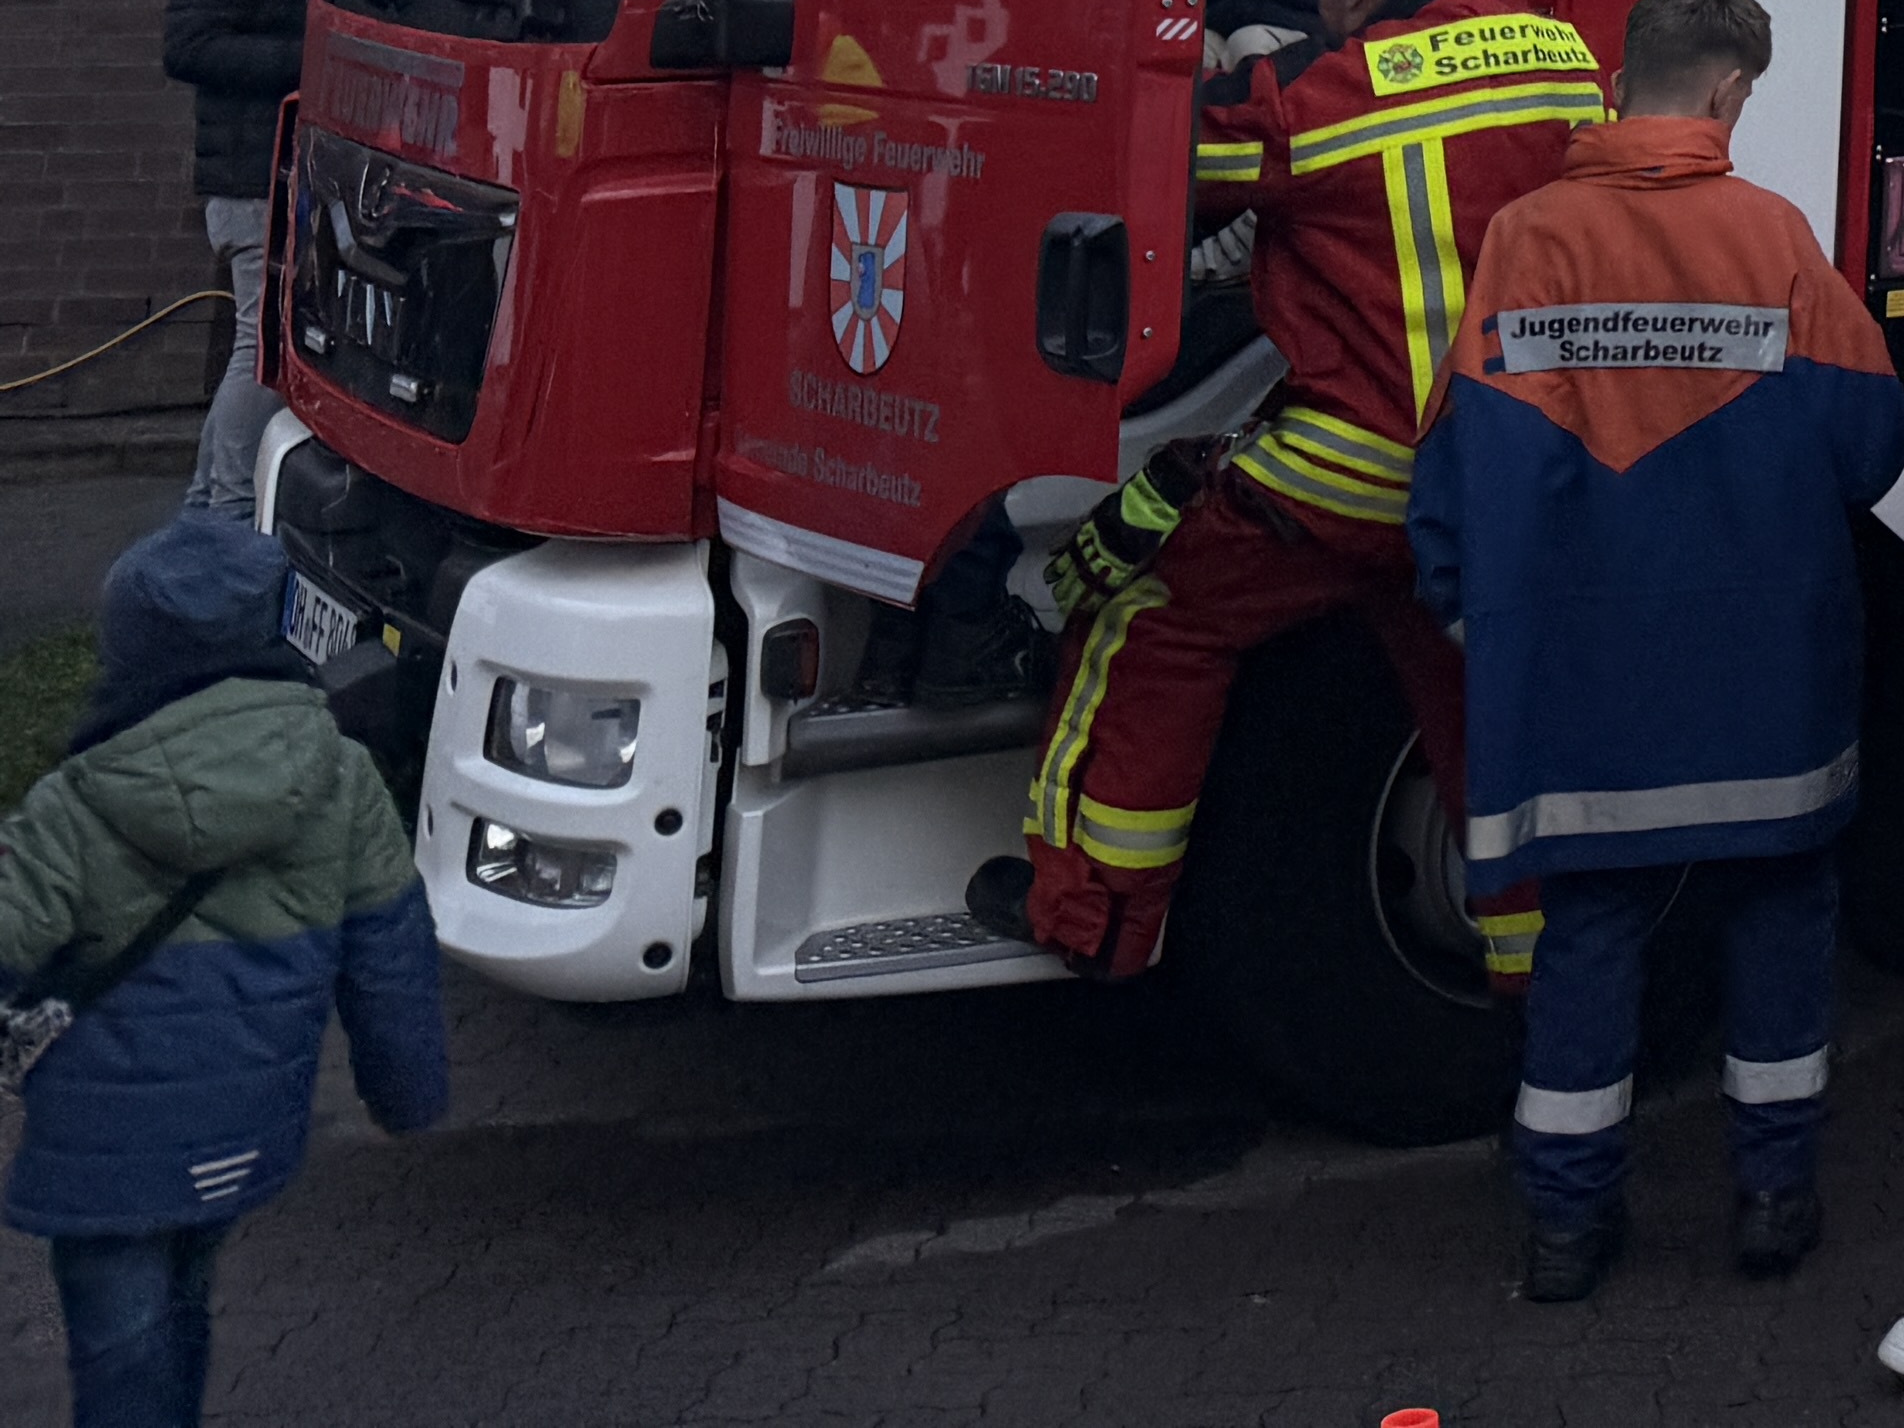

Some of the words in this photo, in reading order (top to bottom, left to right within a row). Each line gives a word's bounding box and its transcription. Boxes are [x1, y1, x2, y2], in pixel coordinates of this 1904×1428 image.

[1429, 24, 1577, 53] Feuerwehr
[1435, 44, 1590, 76] Scharbeutz
[1015, 66, 1098, 104] 15.290
[774, 123, 867, 169] Freiwillige
[873, 131, 986, 179] Feuerwehr
[1510, 310, 1774, 339] Jugendfeuerwehr
[1559, 340, 1723, 363] Scharbeutz
[788, 369, 941, 443] SCHARBEUTZ
[814, 447, 921, 507] Scharbeutz
[309, 595, 329, 657] FF
